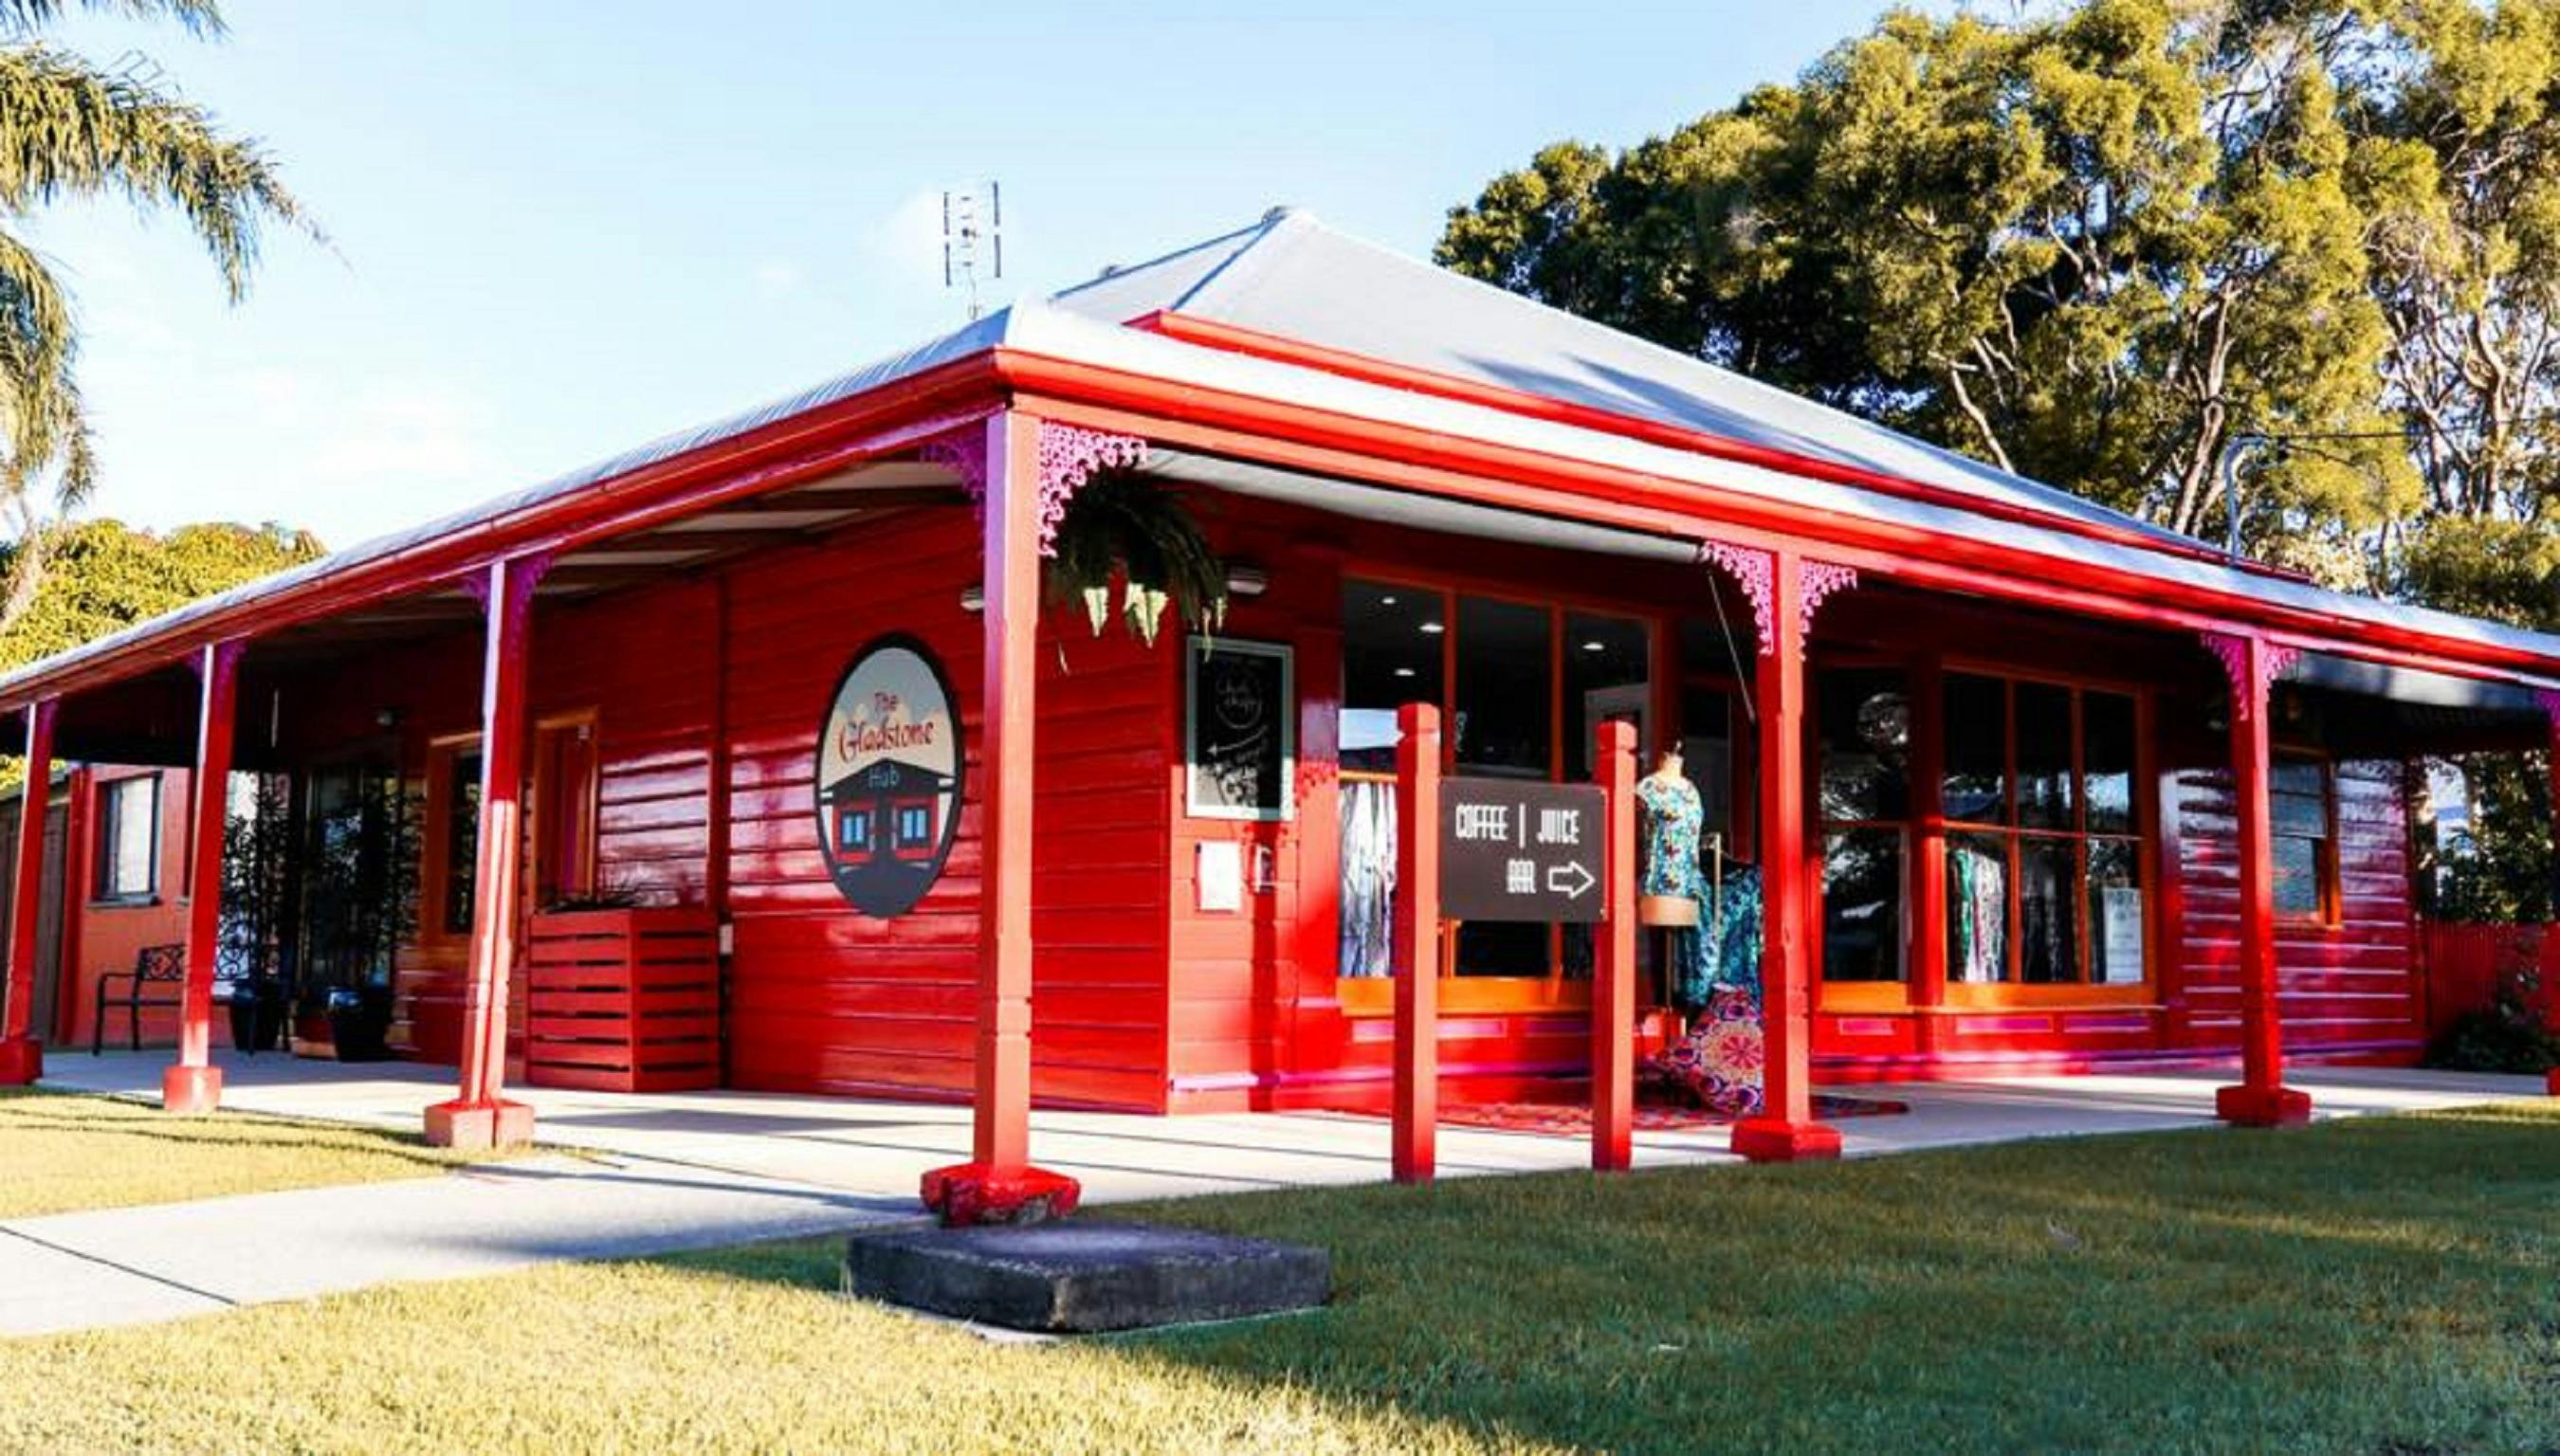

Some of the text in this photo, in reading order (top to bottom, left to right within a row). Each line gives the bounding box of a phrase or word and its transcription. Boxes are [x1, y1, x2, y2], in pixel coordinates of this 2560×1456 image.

[874, 691, 899, 712] The
[839, 717, 934, 763] Gladstone
[869, 764, 900, 789] Hub
[1455, 804, 1580, 845] COFFEE JUICE
[1507, 859, 1536, 894] BAR
